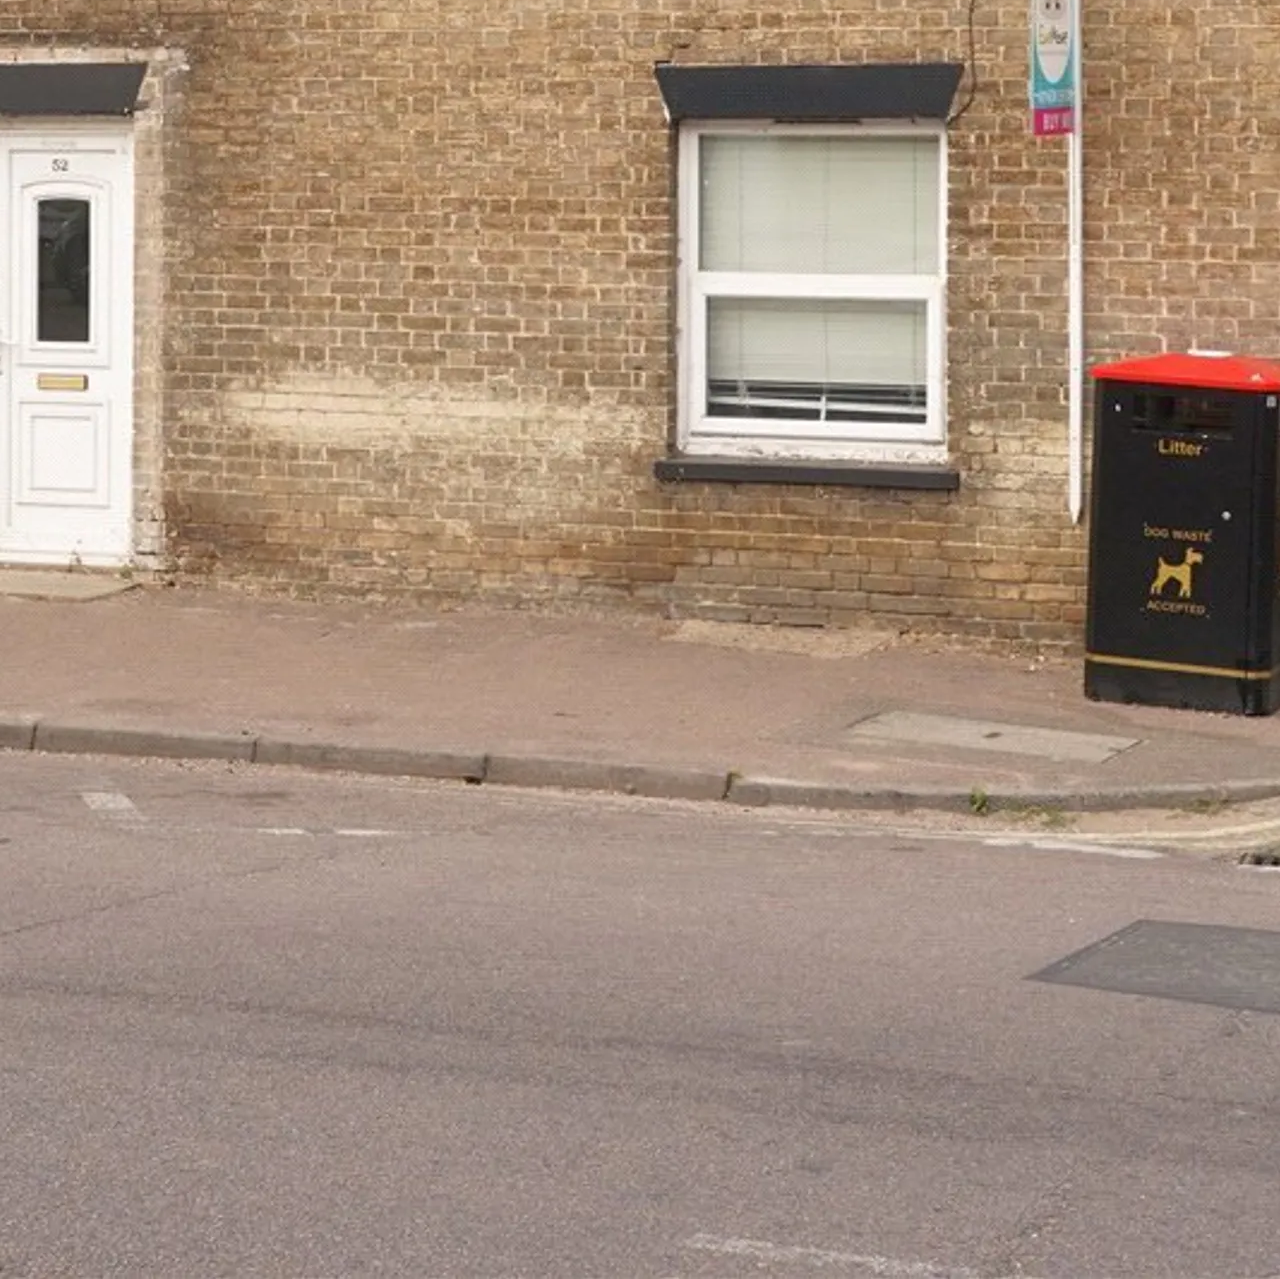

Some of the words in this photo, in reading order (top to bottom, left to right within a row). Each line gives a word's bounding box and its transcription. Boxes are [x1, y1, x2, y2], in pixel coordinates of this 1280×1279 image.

[51, 158, 69, 172] 52
[1158, 438, 1203, 457] Litter
[1143, 525, 1169, 539] DOG
[1172, 529, 1212, 542] WASTE
[1147, 600, 1206, 615] ACCEPTED
